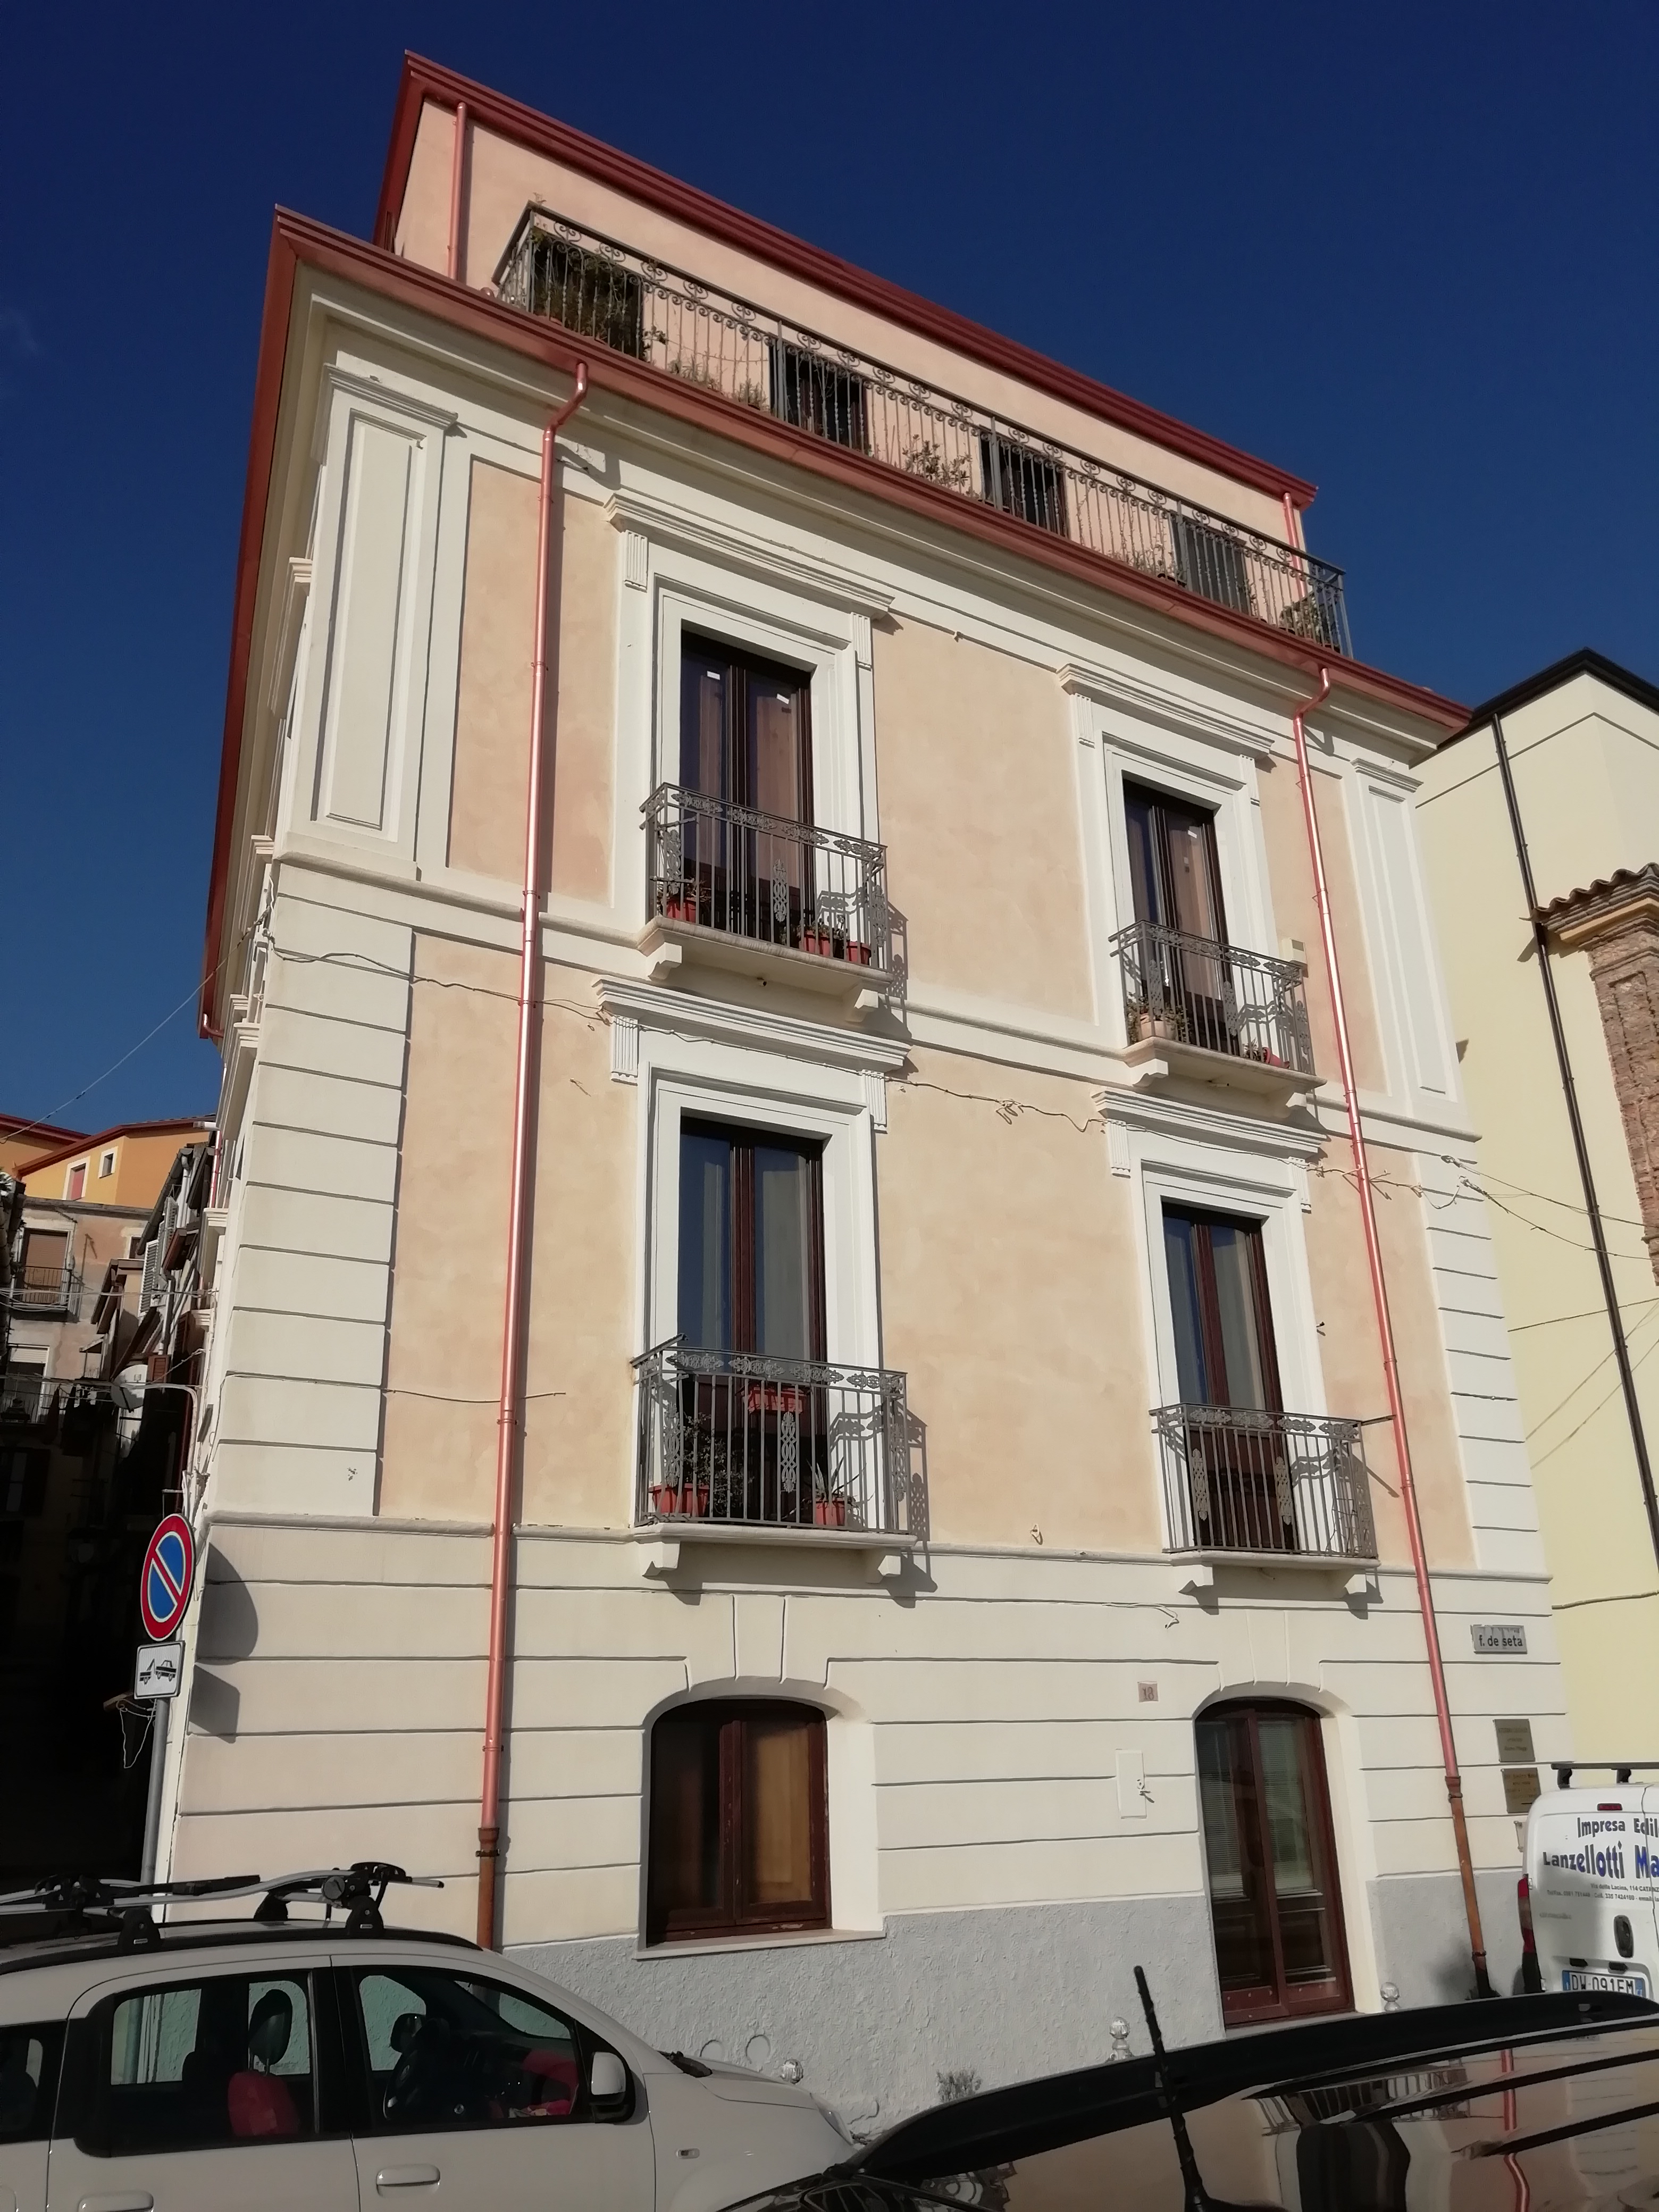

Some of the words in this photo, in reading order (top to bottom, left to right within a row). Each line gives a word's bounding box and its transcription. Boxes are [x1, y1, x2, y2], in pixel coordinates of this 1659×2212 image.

[1478, 1635, 1485, 1646] f.
[1487, 1635, 1499, 1646] de
[1502, 1635, 1523, 1646] seta
[1142, 1686, 1154, 1700] 18
[1577, 1817, 1626, 1838] Impresa
[1633, 1817, 1659, 1838] Edil
[1543, 1840, 1625, 1879] Lanzellotti
[1572, 1975, 1586, 1990] DW
